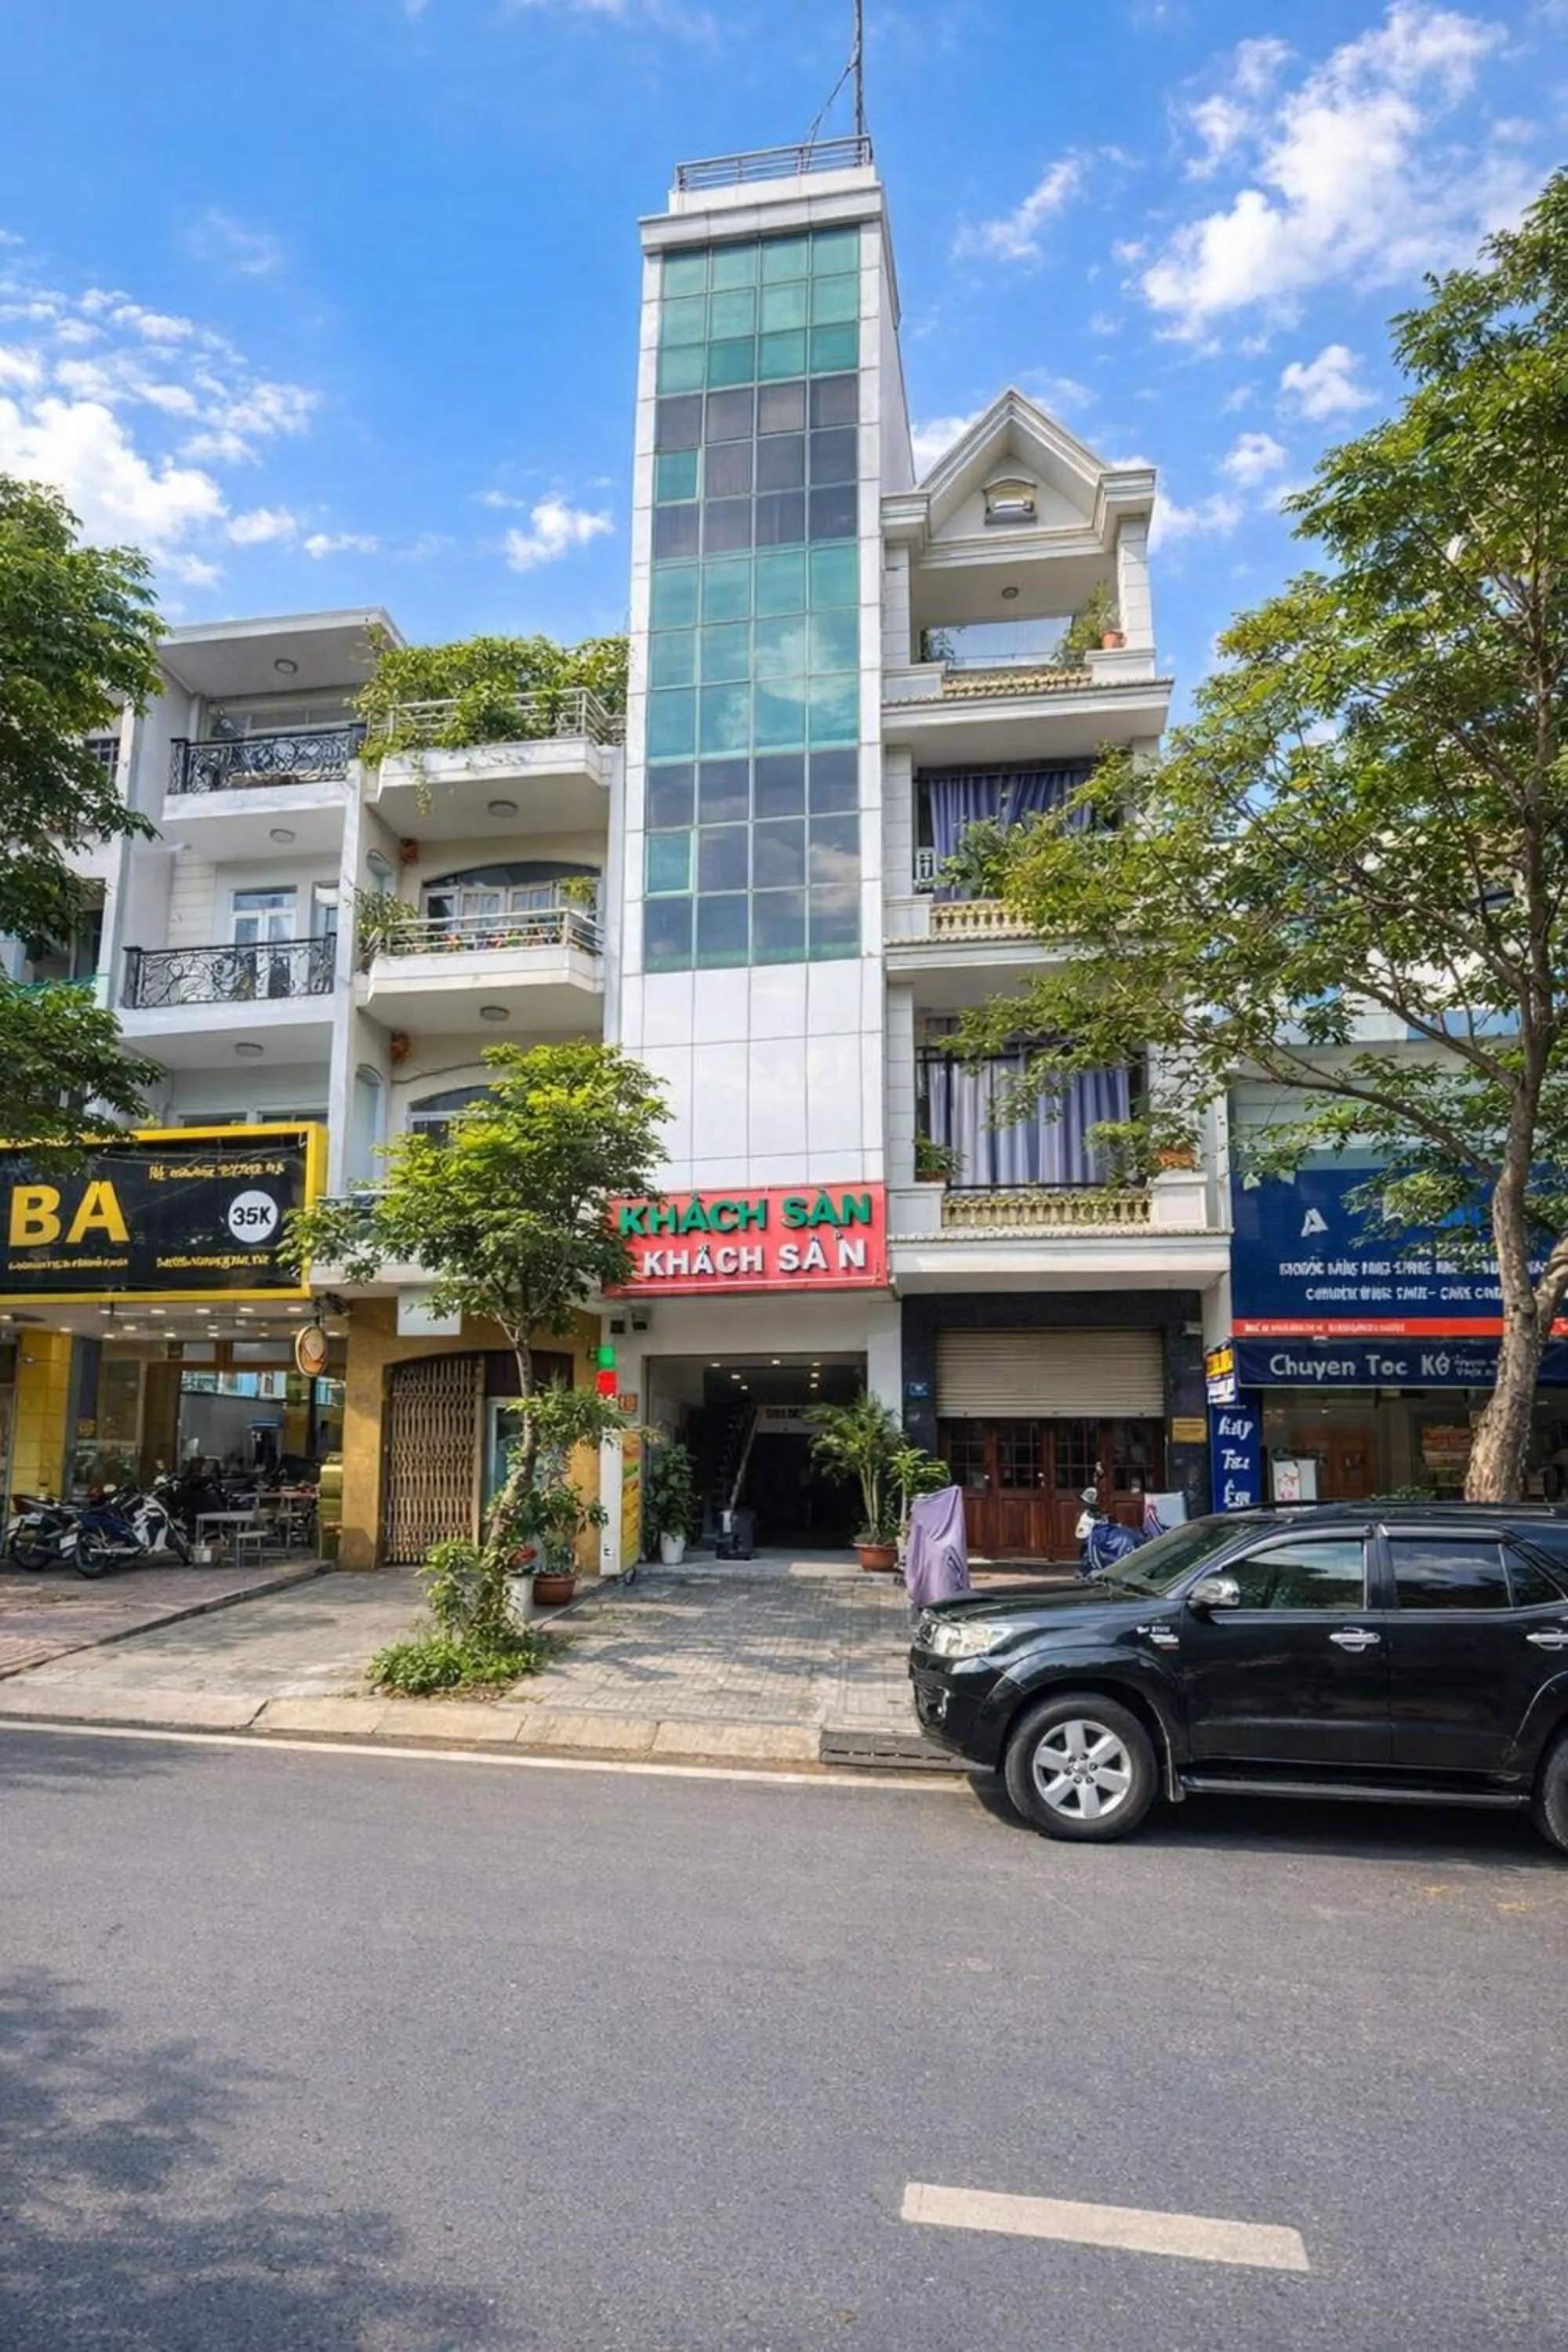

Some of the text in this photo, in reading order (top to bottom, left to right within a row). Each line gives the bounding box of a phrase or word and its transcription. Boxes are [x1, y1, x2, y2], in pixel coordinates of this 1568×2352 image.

[9, 1180, 130, 1247] BA
[232, 1207, 272, 1227] 35K
[1269, 1354, 1356, 1381] Chuyen
[1365, 1354, 1408, 1375] Toc
